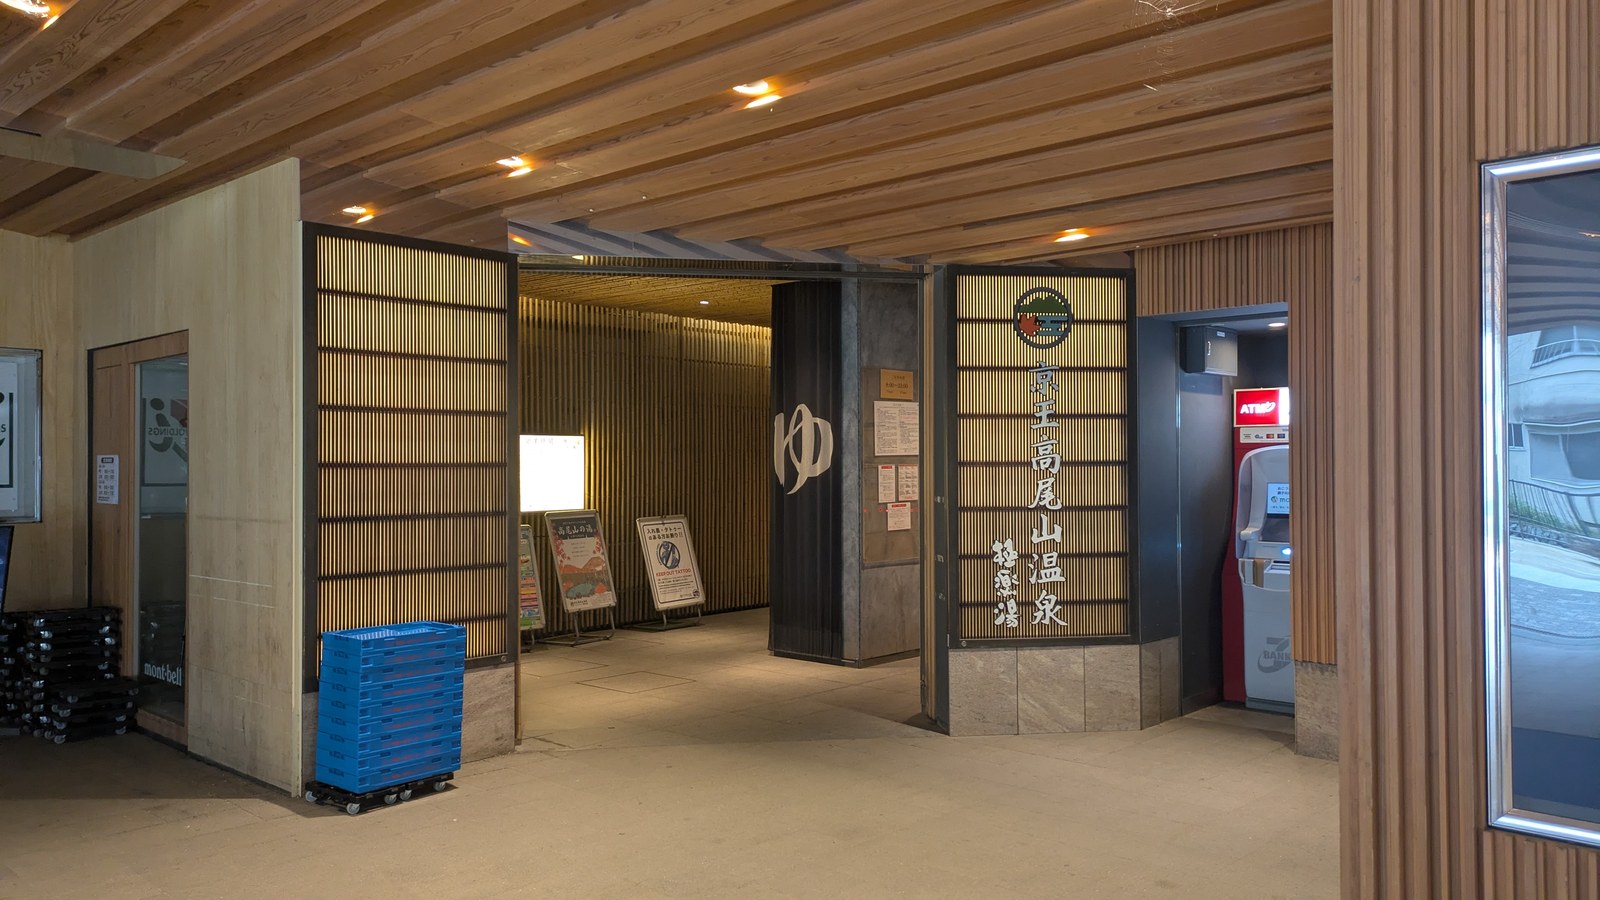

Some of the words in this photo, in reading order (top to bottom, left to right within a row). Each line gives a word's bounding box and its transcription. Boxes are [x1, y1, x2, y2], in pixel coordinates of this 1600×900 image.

[774, 403, 834, 495] ゆ
[1240, 403, 1267, 414] ATM
[1028, 361, 1068, 626] 京王高尾山温泉
